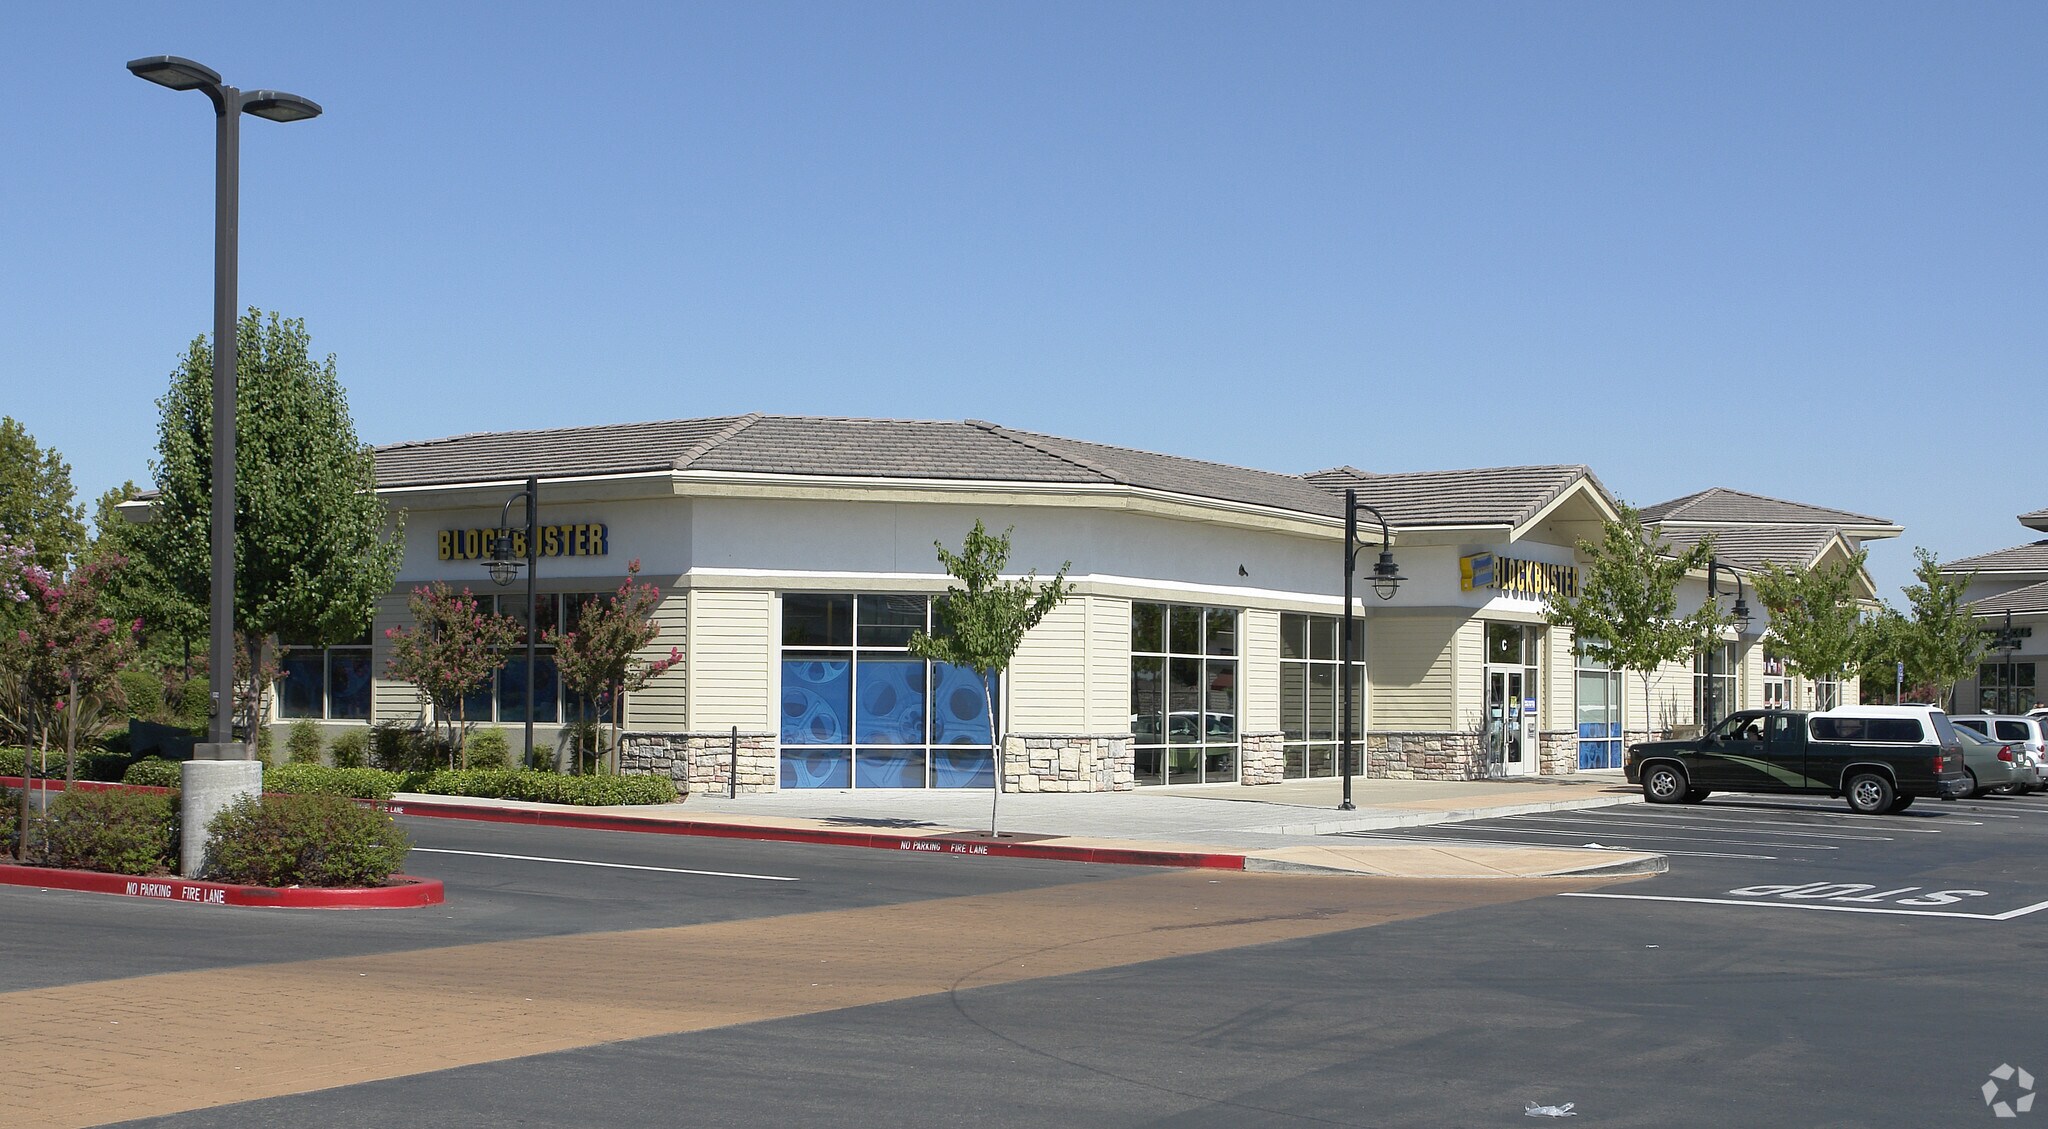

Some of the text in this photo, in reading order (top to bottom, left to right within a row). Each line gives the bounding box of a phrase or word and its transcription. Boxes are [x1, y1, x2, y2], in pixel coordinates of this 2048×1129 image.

[1493, 555, 1579, 598] BLOCKBUSTER
[1501, 639, 1507, 651] C
[900, 840, 988, 855] NO PARKING FIRE LANE
[126, 881, 226, 904] NO PARKING FIRE LANE
[1725, 881, 1989, 906] STOP
